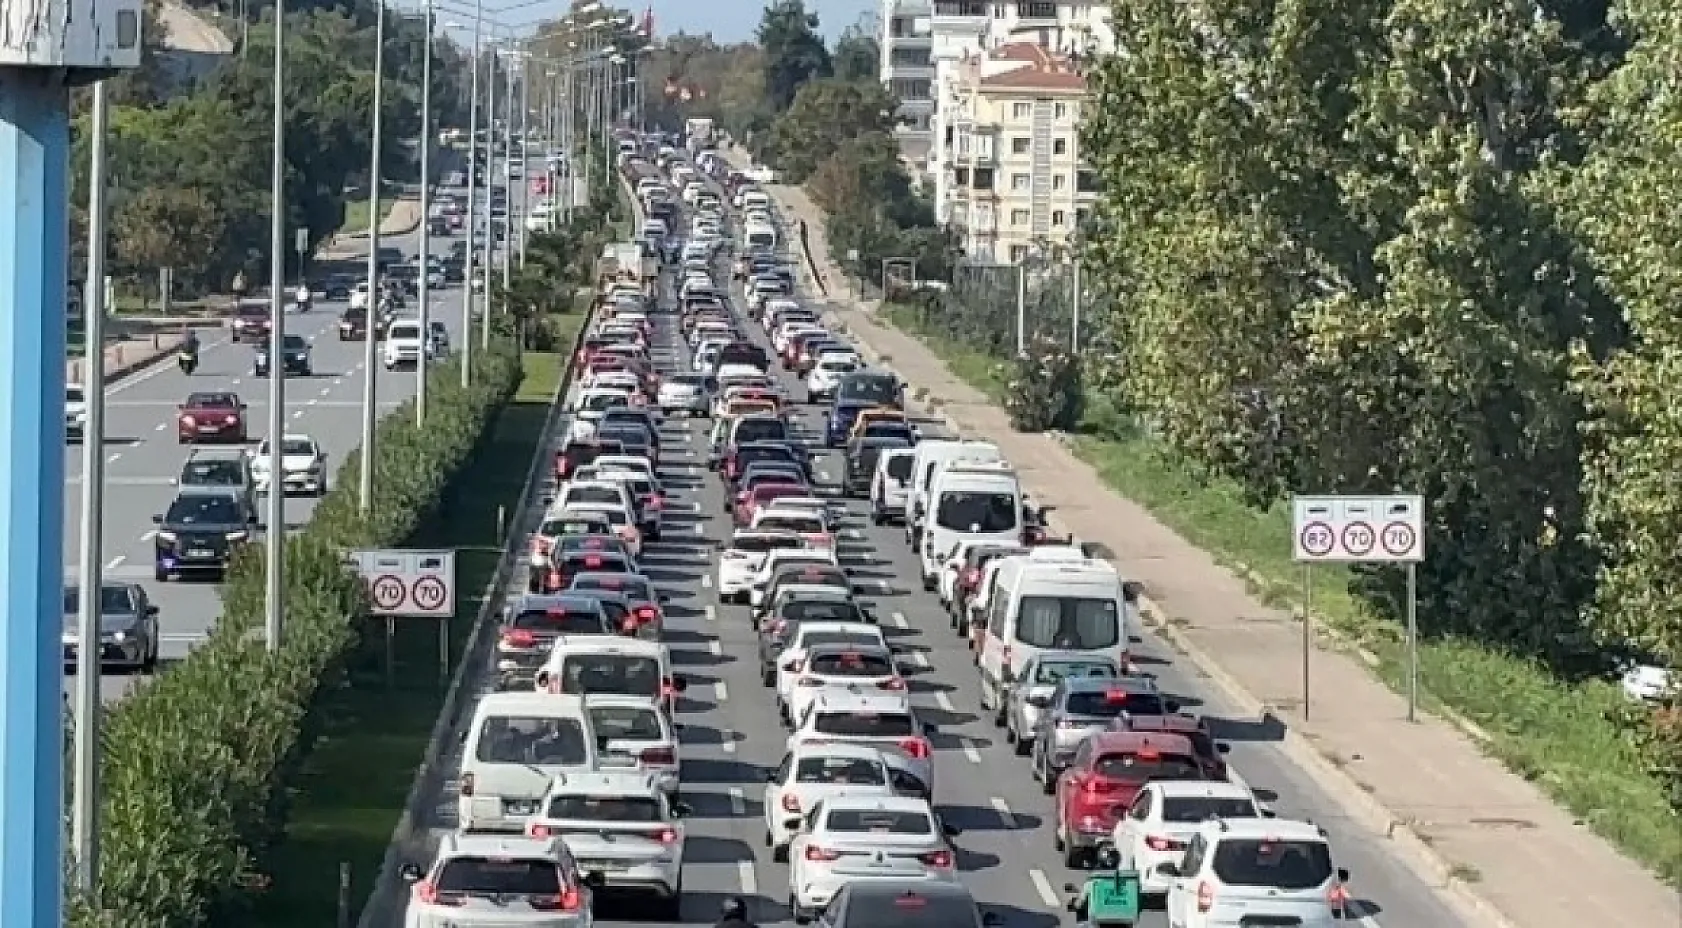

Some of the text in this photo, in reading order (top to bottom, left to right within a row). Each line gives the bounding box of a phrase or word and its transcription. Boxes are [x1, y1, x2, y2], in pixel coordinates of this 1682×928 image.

[1308, 532, 1329, 545] 82
[1348, 531, 1369, 545] 70
[1386, 531, 1408, 545] 70
[381, 585, 399, 599] 70
[420, 586, 440, 601] 70
